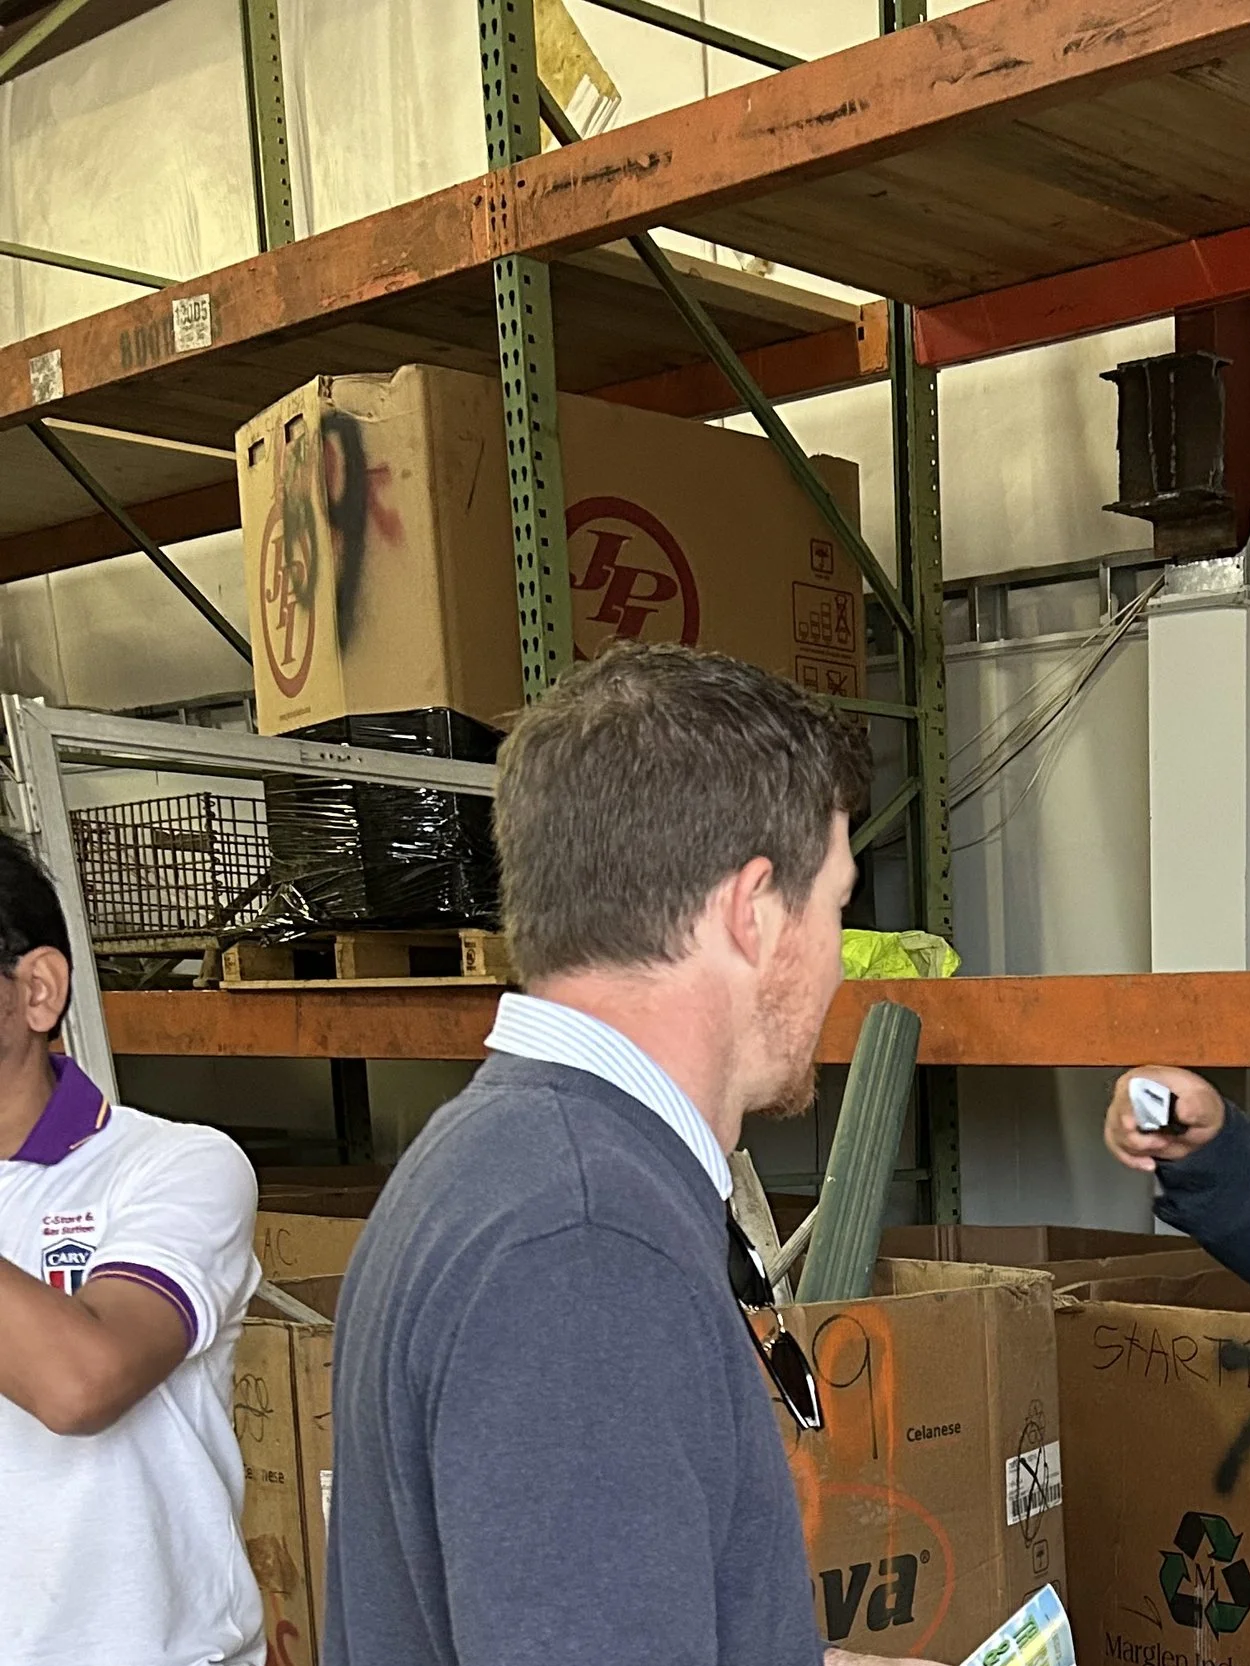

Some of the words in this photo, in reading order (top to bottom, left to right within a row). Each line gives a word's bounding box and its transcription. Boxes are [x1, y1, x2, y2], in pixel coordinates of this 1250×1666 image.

[49, 1251, 89, 1266] CARY
[906, 1420, 962, 1443] Celanese
[244, 1464, 285, 1485] enese
[1194, 1563, 1216, 1591] M
[812, 1553, 918, 1642] va
